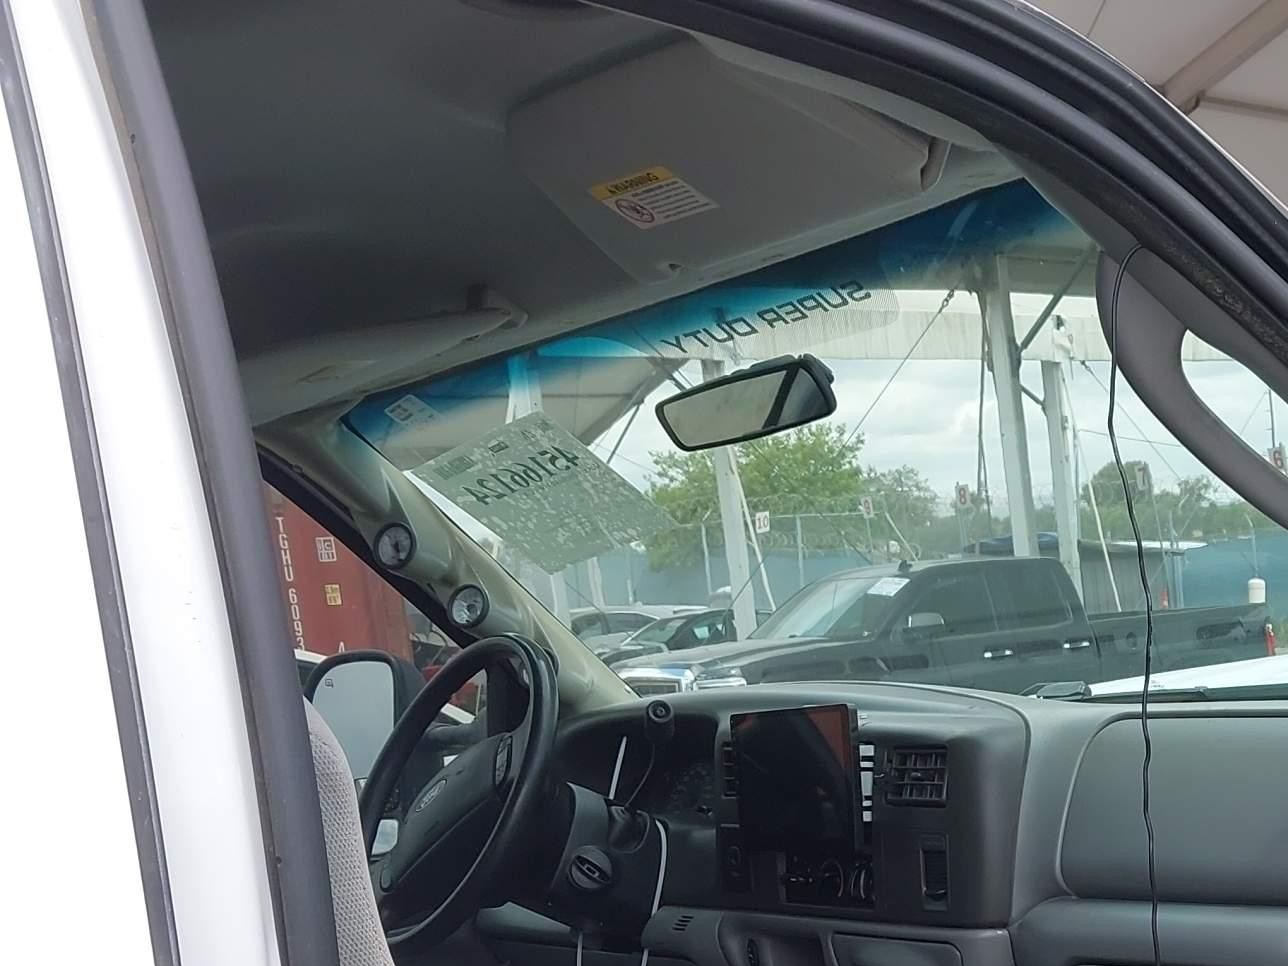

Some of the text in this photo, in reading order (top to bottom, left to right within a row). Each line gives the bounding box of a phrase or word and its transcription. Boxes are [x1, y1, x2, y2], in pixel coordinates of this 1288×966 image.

[1273, 450, 1284, 468] 6
[960, 487, 967, 505] 8
[757, 514, 769, 530] 10
[274, 516, 294, 582] TGHU
